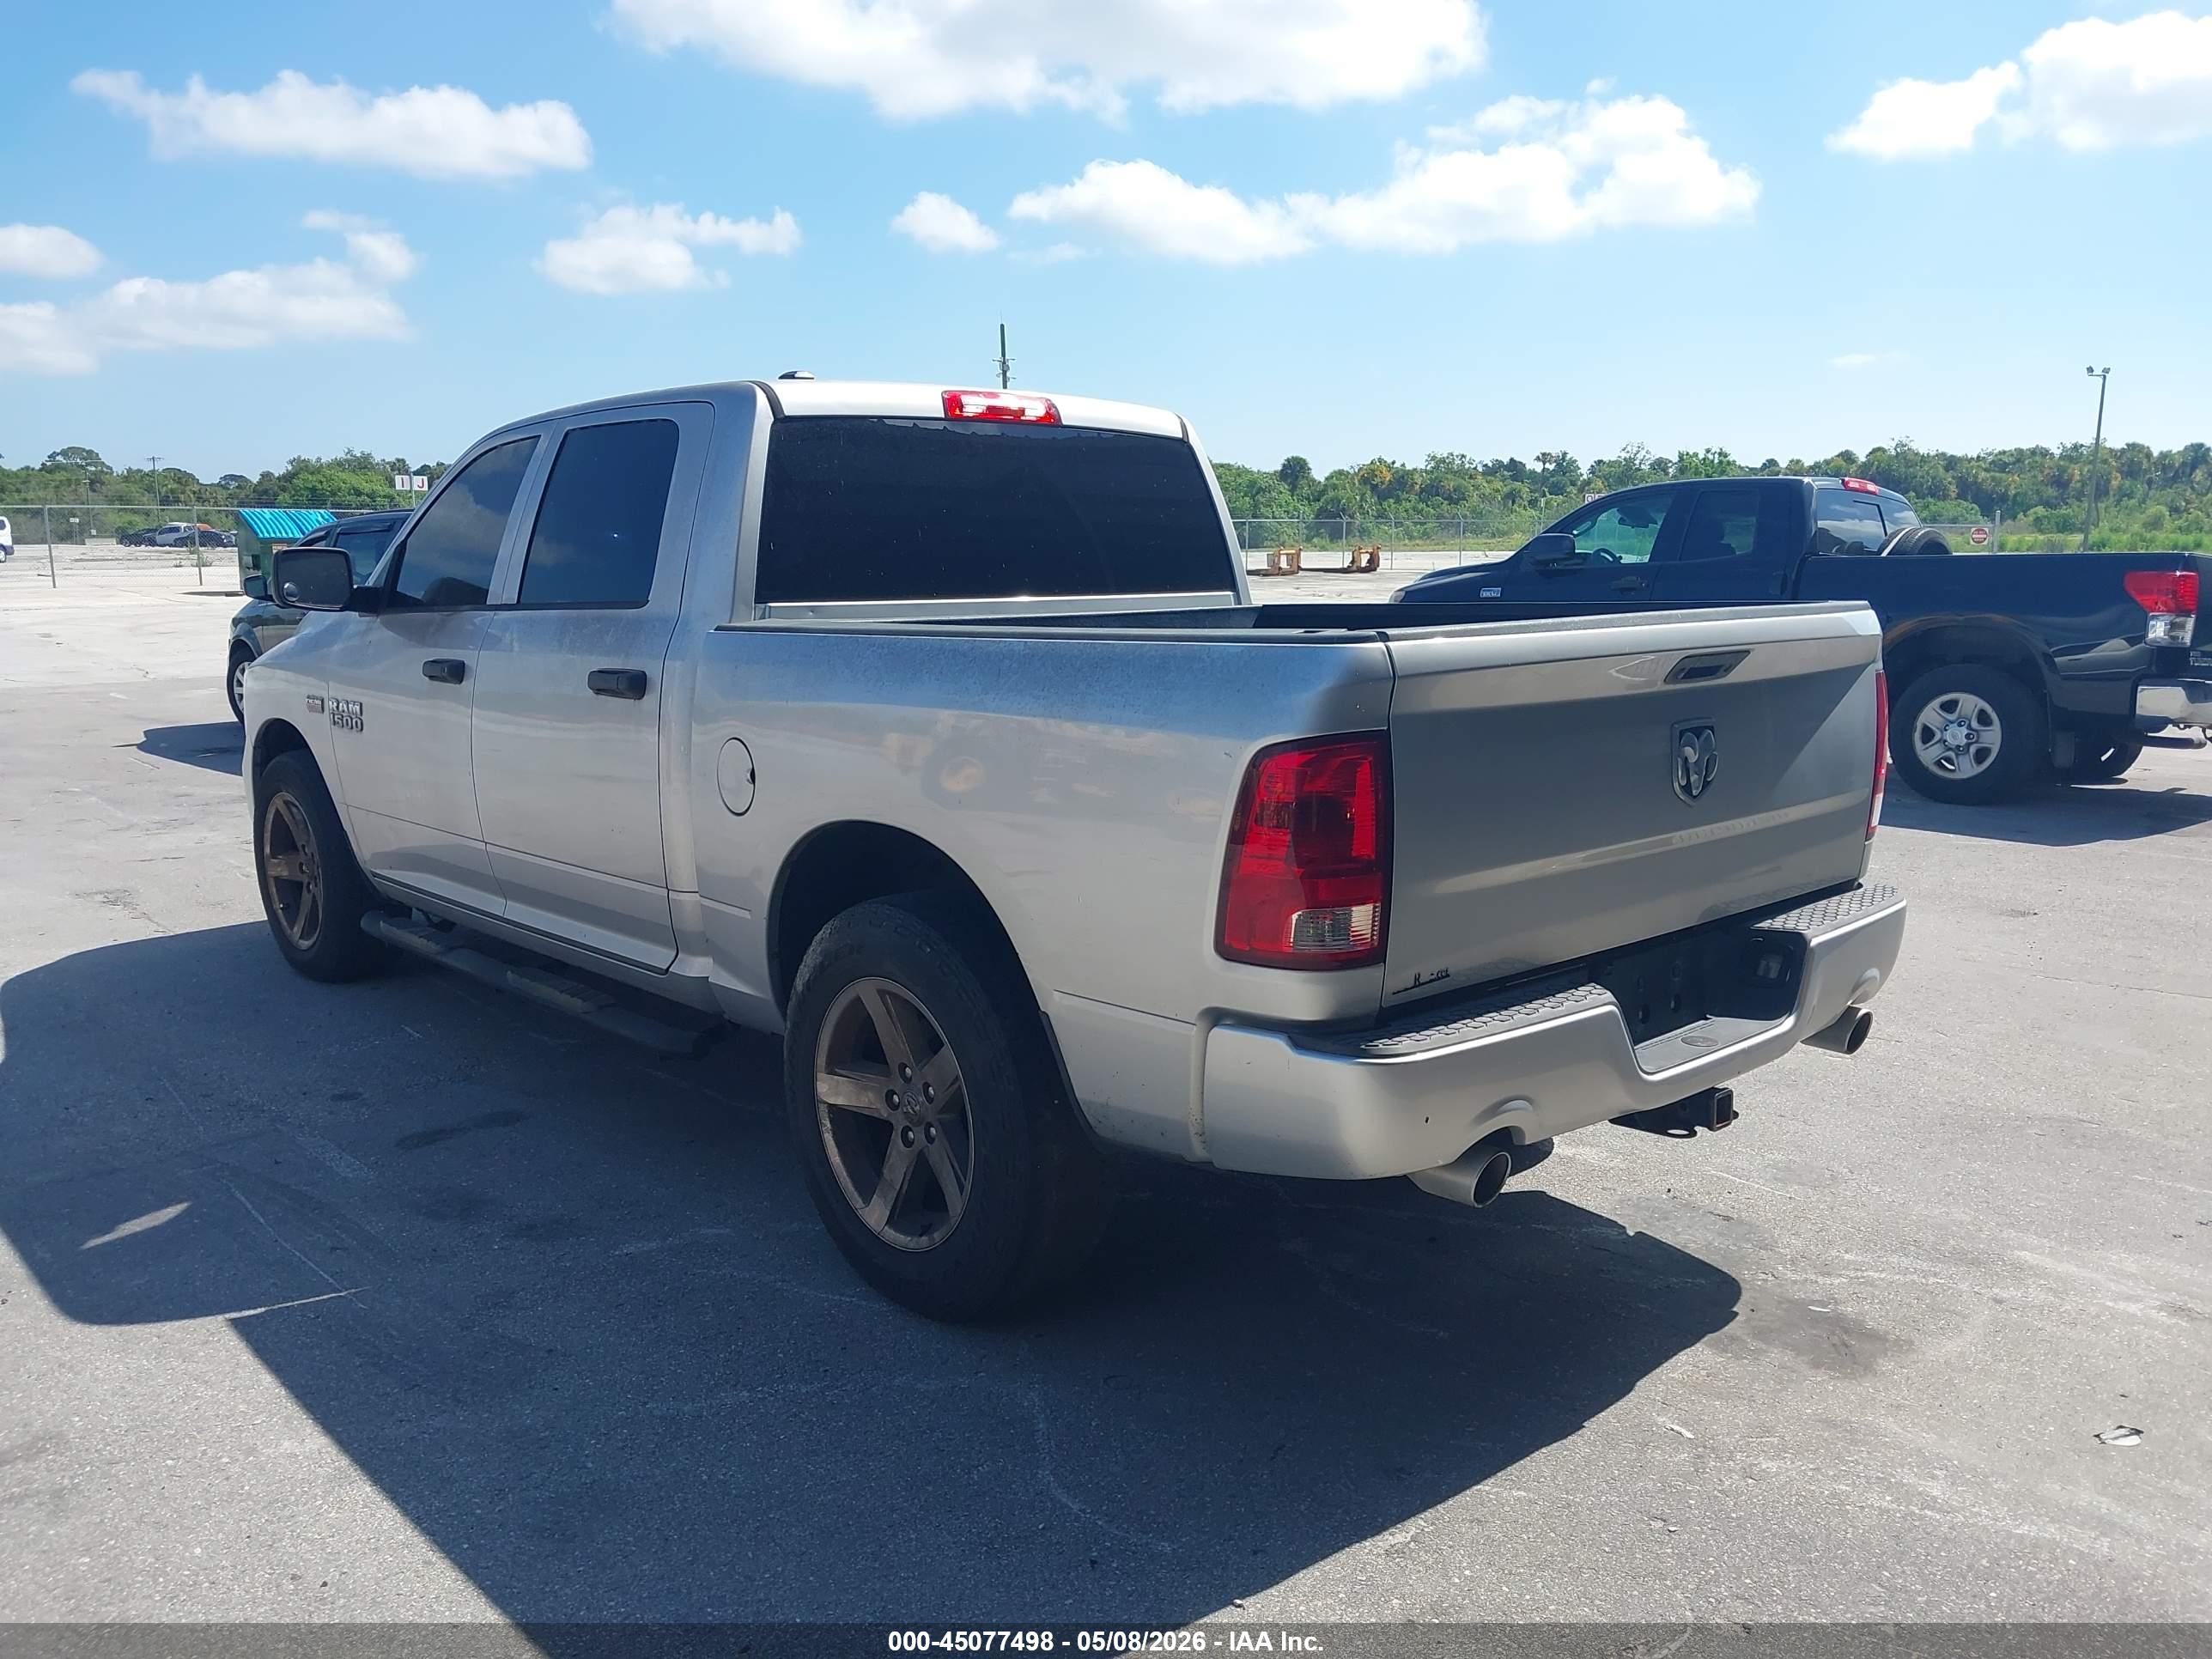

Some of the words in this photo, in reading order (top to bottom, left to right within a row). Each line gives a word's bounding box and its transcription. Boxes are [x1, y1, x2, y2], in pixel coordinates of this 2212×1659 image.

[417, 477, 425, 489] J
[329, 697, 363, 717] RAM
[330, 712, 364, 732] 1500
